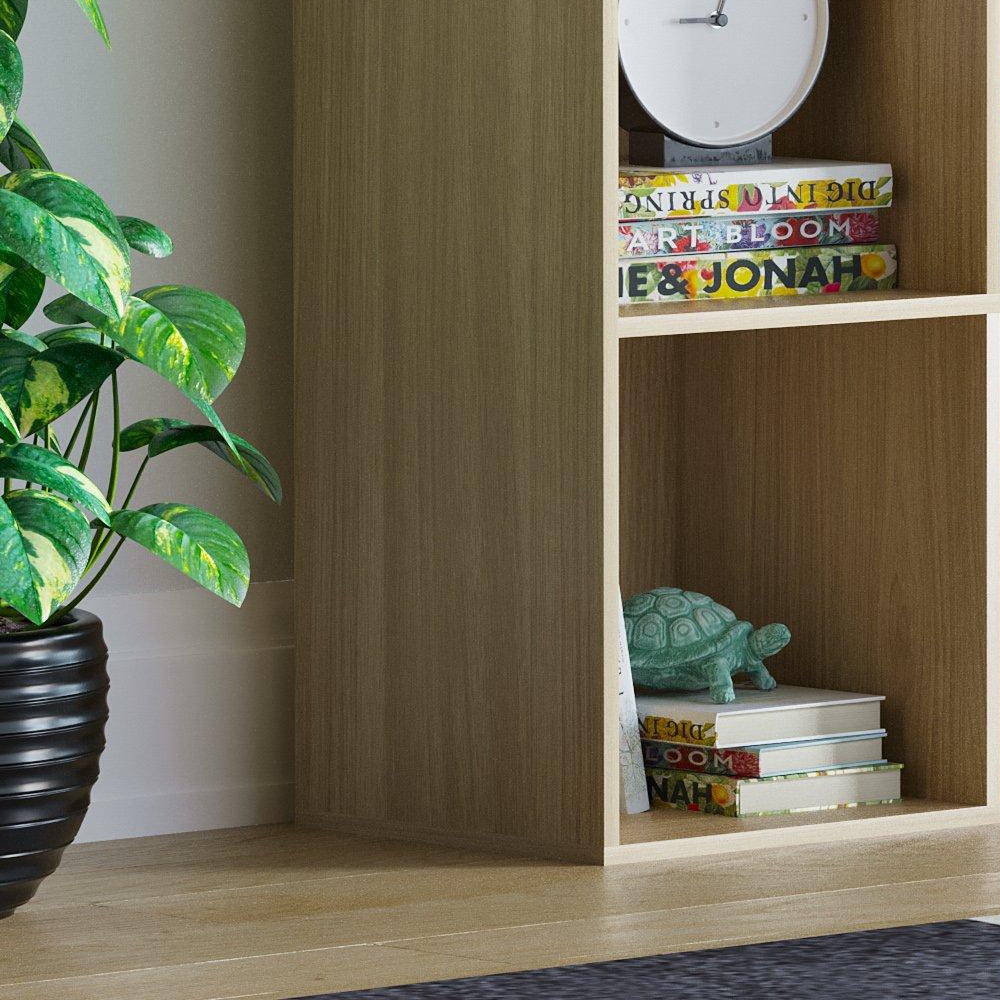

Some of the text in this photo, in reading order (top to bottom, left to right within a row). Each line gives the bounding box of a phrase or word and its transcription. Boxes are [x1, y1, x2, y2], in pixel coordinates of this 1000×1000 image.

[625, 180, 877, 214] DIG INTO SPRING
[626, 219, 852, 251] ART BLOOM
[703, 254, 862, 294] JONAH
[665, 720, 705, 741] DIG
